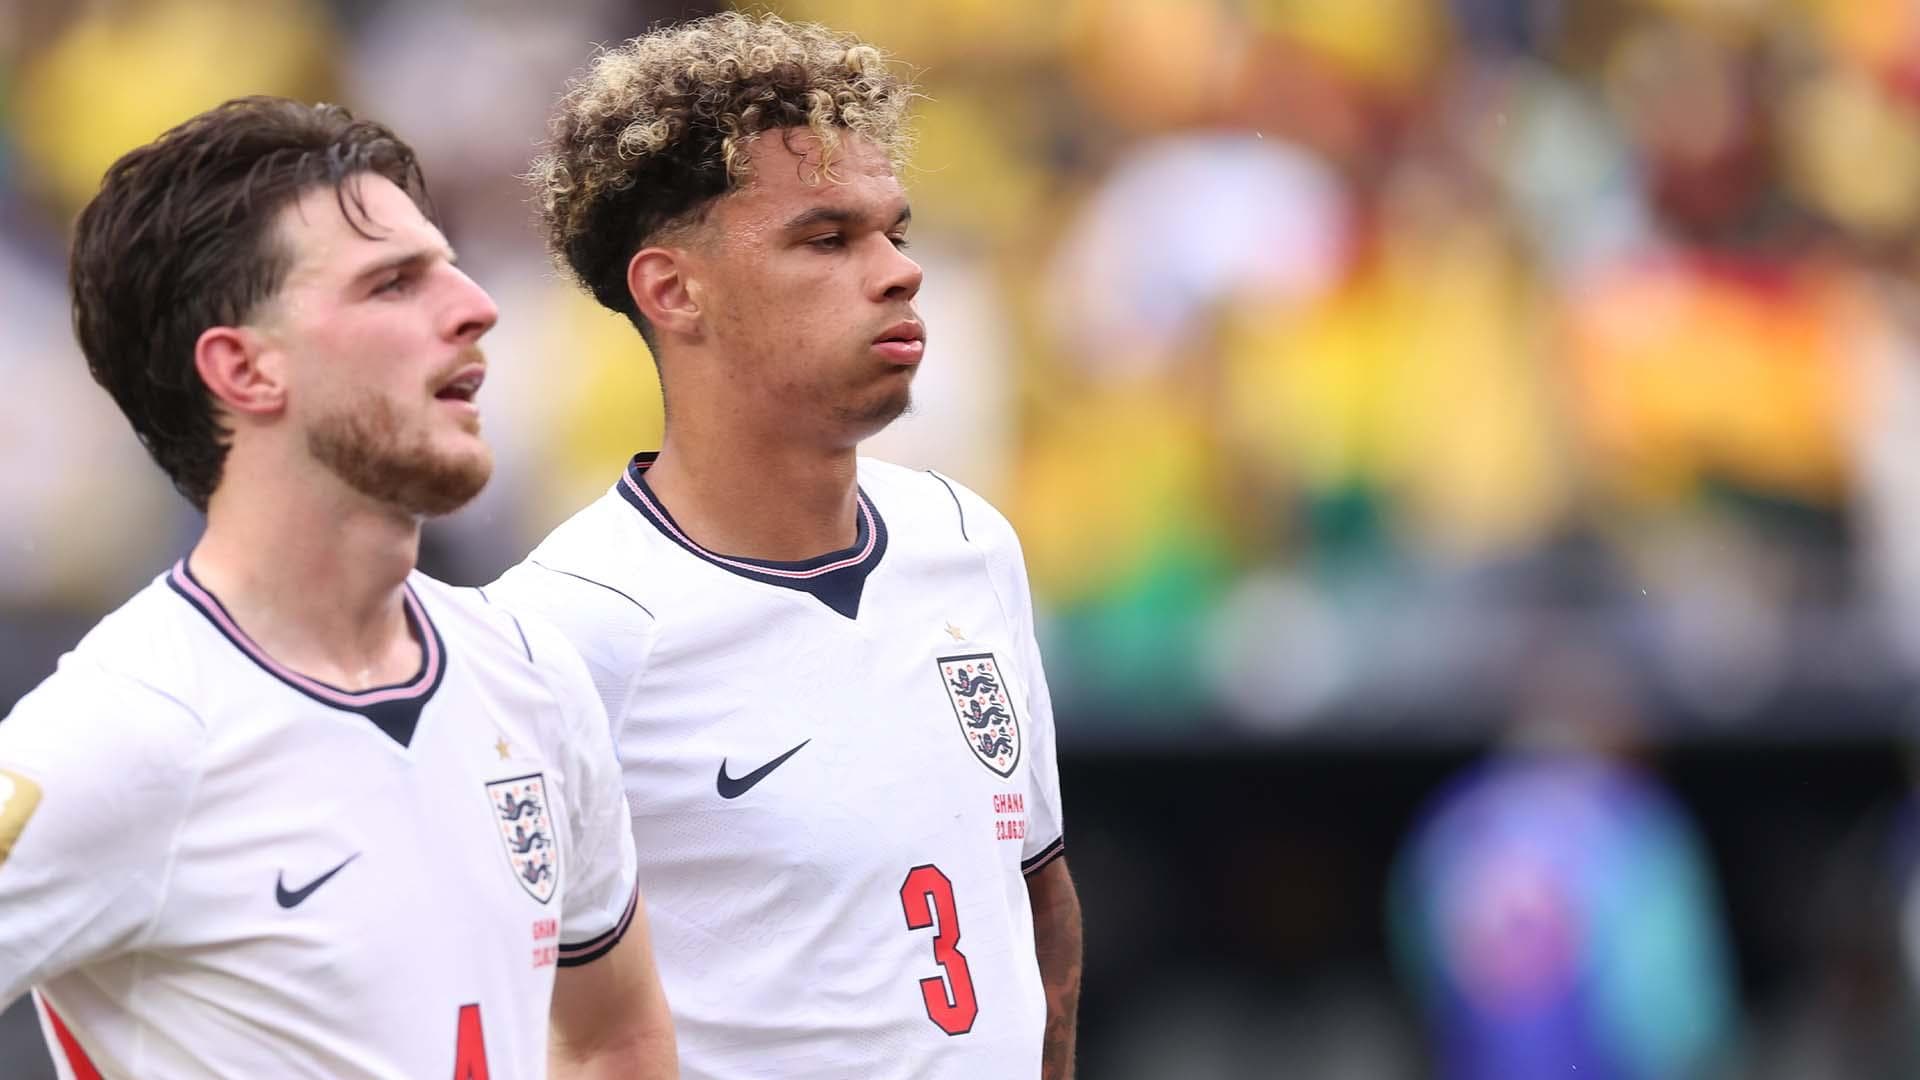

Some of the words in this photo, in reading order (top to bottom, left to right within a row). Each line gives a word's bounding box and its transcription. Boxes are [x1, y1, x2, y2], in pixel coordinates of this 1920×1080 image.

[993, 793, 1025, 813] GHANA
[995, 820, 1025, 841] 23.06.2
[900, 864, 978, 1036] 3
